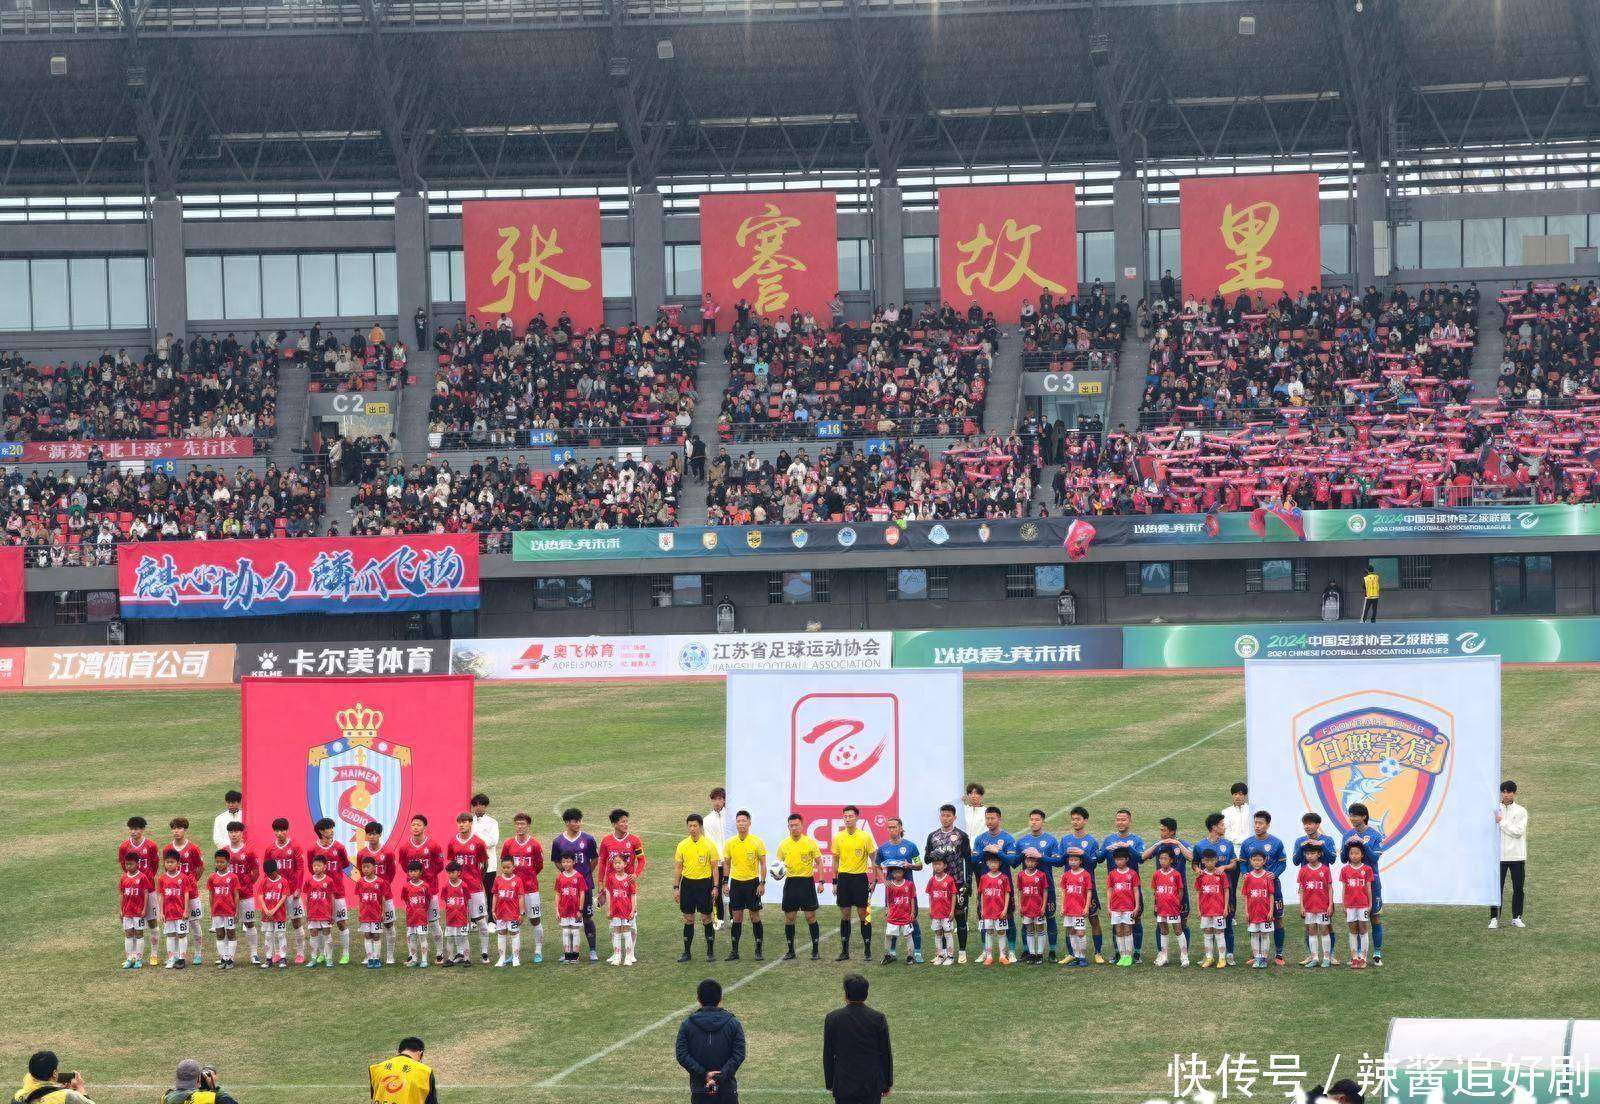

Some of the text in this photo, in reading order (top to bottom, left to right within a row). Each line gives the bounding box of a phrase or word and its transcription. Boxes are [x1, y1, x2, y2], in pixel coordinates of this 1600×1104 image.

[479, 226, 591, 314] 张
[956, 218, 1067, 296] 故
[1219, 201, 1285, 296] 里
[1044, 373, 1074, 392] C3
[1080, 384, 1099, 393] 出口
[333, 394, 364, 412] C2
[368, 406, 386, 414] 出口
[39, 440, 238, 460] “新苏北上海” 先行区
[1267, 632, 1449, 648] 2024中国足球协会乙级联赛
[554, 644, 614, 658] 奥飞体育
[713, 638, 880, 660] 江苏省足球运动协会
[48, 650, 210, 680] 江湾体育公司
[288, 647, 434, 676] 卡尔美体育
[812, 659, 880, 670] ASSOCIATION
[340, 769, 378, 784] HAIMEN
[342, 808, 369, 827] CODIO
[478, 906, 484, 914] 9
[998, 918, 1008, 927] 28
[1076, 918, 1084, 926] 25
